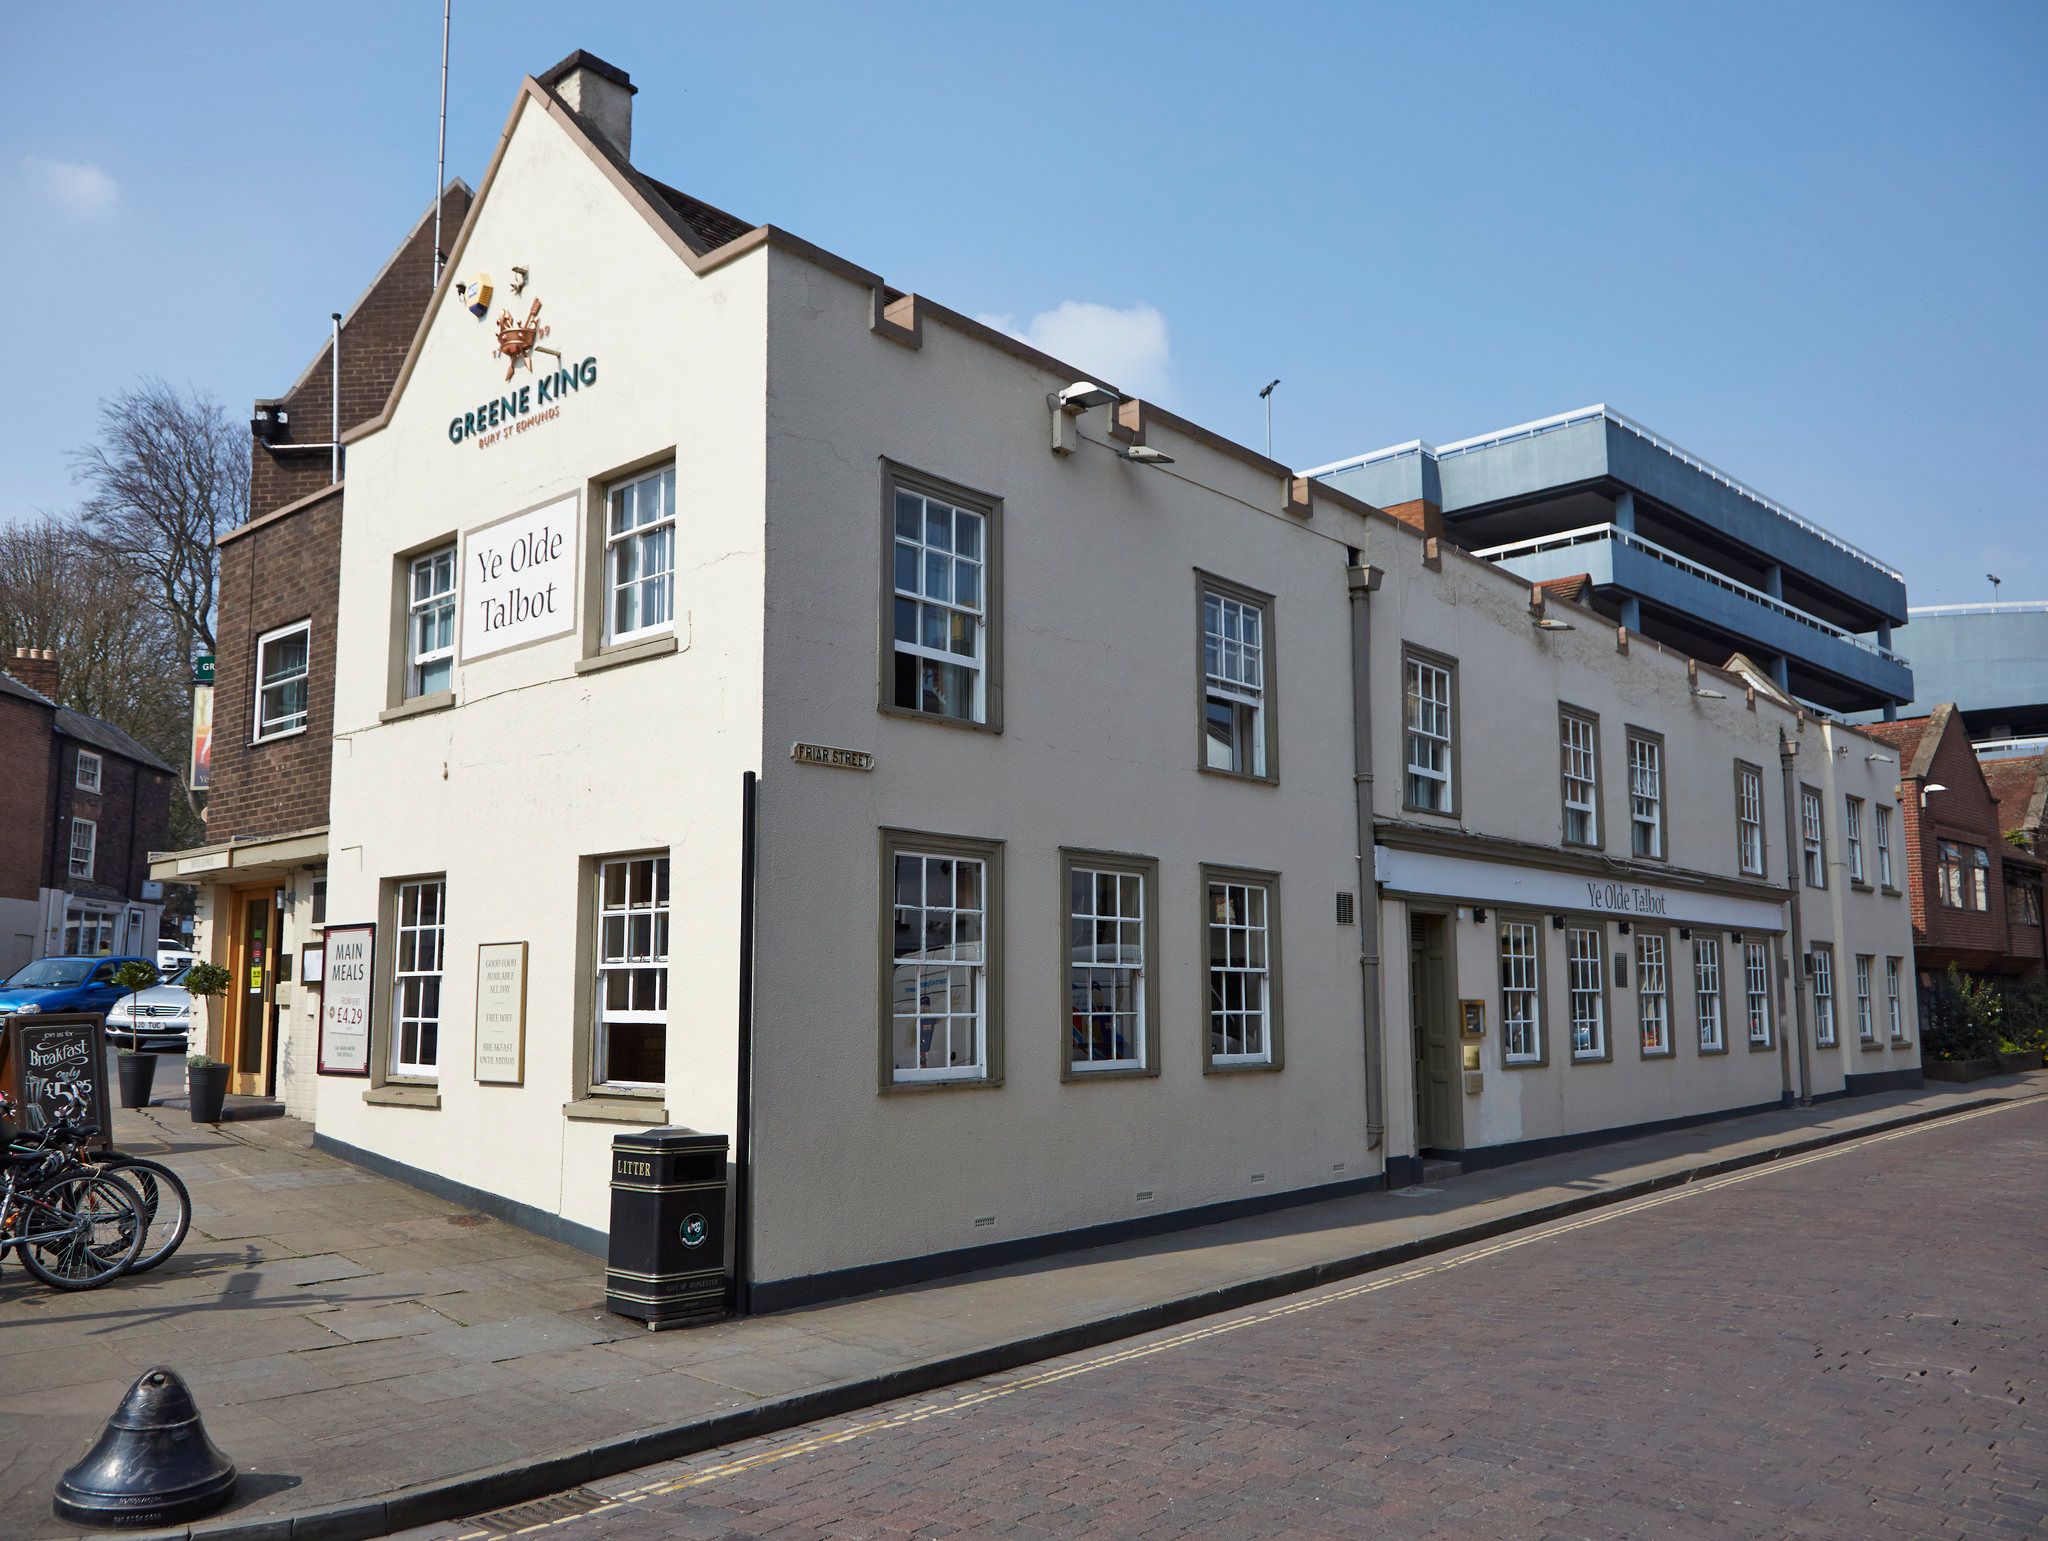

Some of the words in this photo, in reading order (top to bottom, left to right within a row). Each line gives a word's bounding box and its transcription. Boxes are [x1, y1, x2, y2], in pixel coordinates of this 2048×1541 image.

[448, 385, 530, 444] GREENE
[538, 356, 597, 405] KING
[478, 432, 501, 449] BURY
[503, 425, 513, 439] ST
[516, 405, 560, 434] EDMUNDS
[478, 549, 502, 583] Ye
[510, 526, 562, 572] Olde
[480, 582, 557, 632] Talbot
[799, 745, 829, 762] FRIAR
[832, 750, 870, 768] STREET
[1587, 882, 1602, 907] Ye
[1605, 884, 1630, 910] Olde
[1632, 888, 1667, 915] Talbot
[335, 942, 363, 961] MAIN
[332, 963, 364, 981] MEALS
[486, 959, 501, 968] GOOD
[502, 958, 517, 967] FOOD
[487, 972, 514, 980] AVAILABLE
[489, 985, 499, 994] ALL
[500, 984, 511, 993] DAY
[337, 1007, 363, 1025] £4.29
[486, 1013, 499, 1022] FREE
[29, 1039, 90, 1067] Breakfast
[483, 1043, 513, 1052] BREAKFAST
[480, 1056, 495, 1065] UNTIL
[495, 1056, 515, 1066] MIDDAY
[617, 1160, 651, 1177] LITTER
